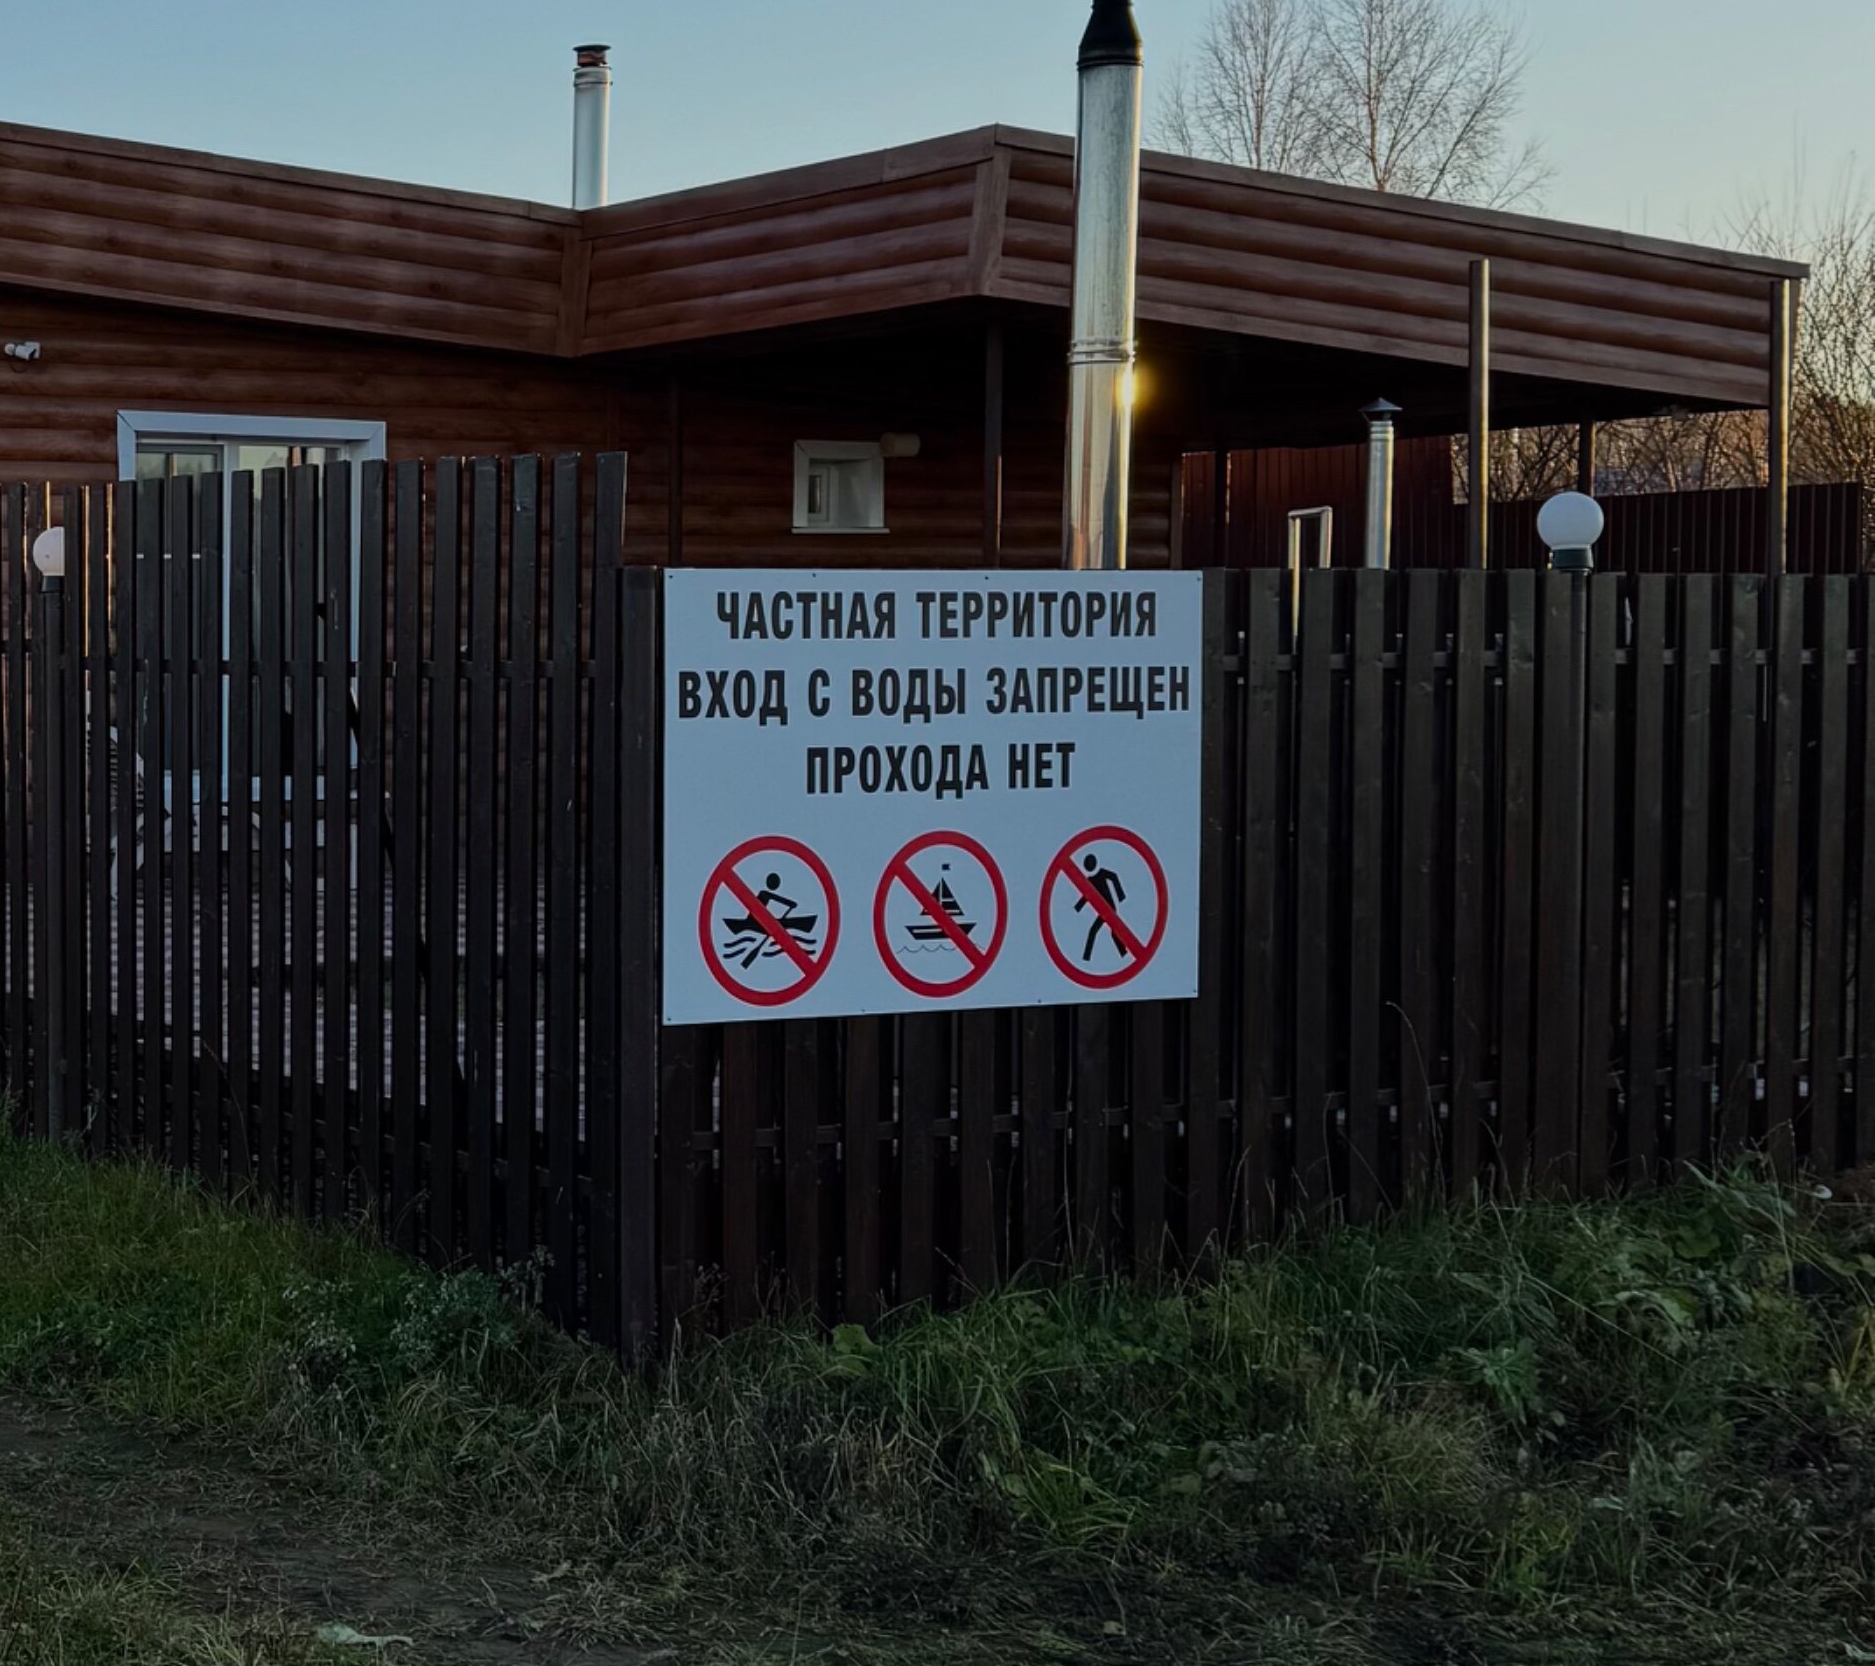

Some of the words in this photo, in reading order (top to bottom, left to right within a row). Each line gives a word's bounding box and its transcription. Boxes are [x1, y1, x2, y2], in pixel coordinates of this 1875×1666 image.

[717, 591, 896, 640] ЧАСТНАЯ
[915, 590, 1156, 639] ТЕРРИТОРИЯ
[678, 669, 788, 727] ВХОД
[808, 668, 831, 717] С
[852, 668, 966, 724] ВОДЫ
[986, 666, 1190, 720] ЗАПРЕЩЕН
[806, 744, 990, 800] ПРОХОДА
[1008, 742, 1076, 789] НЕТ
